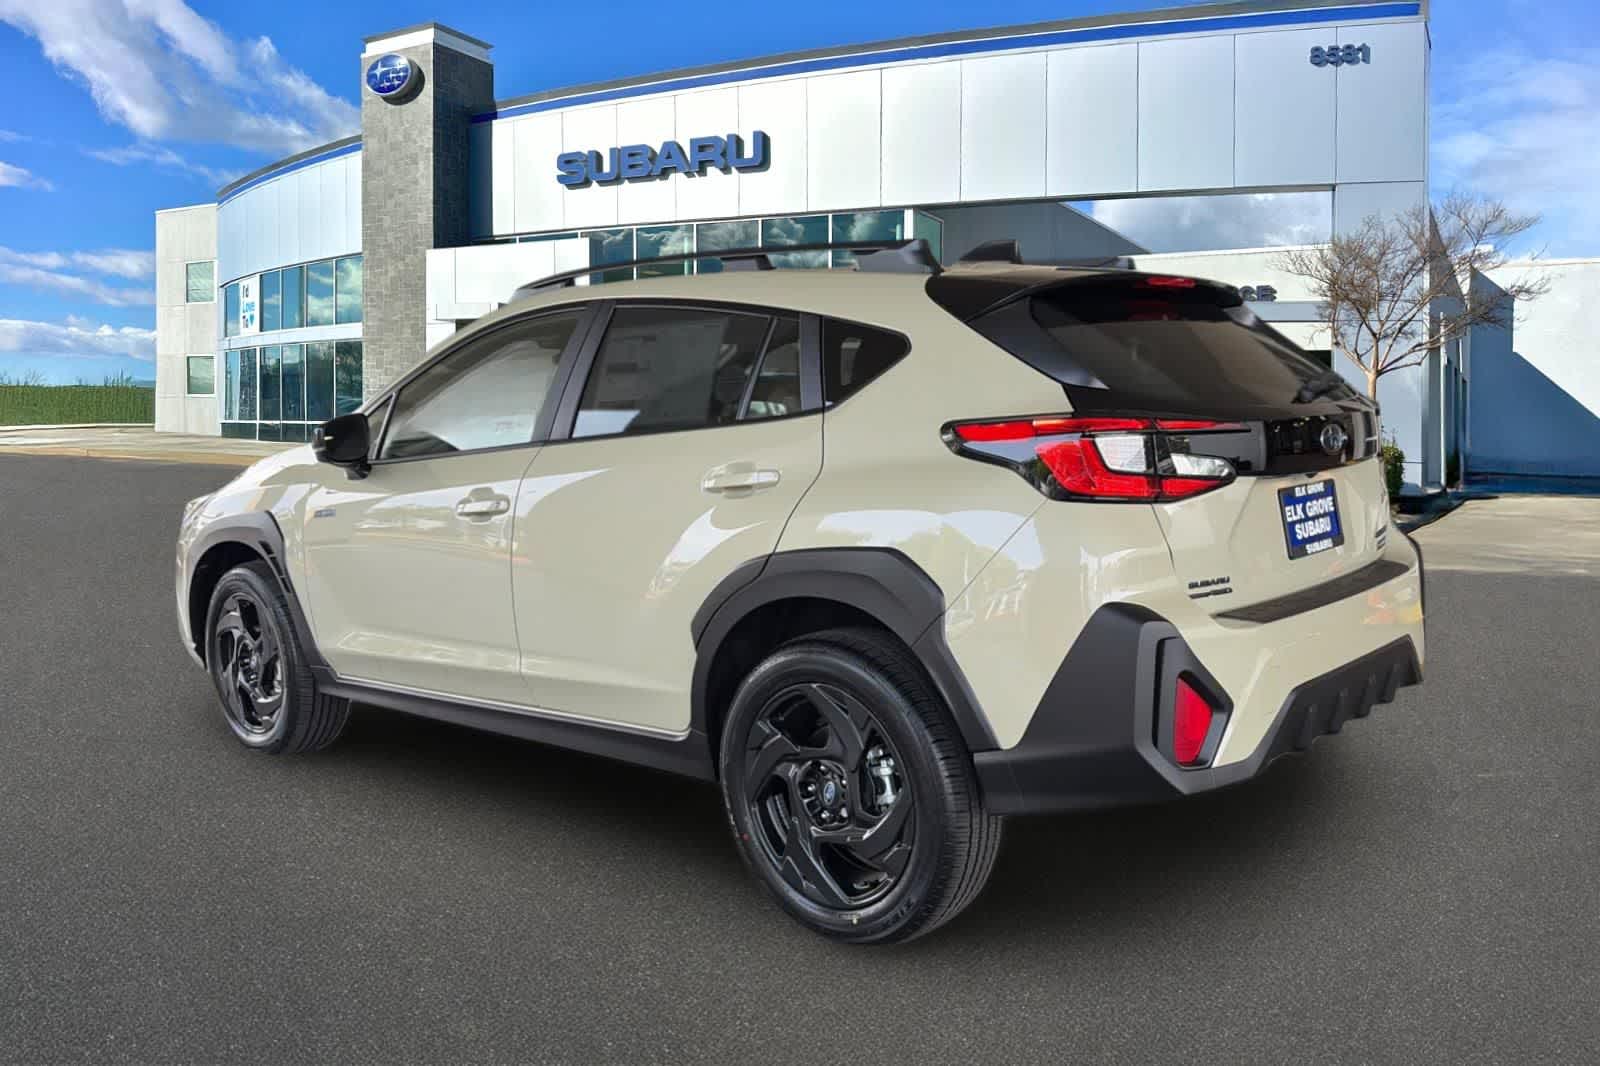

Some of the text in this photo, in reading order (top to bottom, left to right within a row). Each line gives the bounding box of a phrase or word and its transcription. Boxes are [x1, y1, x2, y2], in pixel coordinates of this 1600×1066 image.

[556, 130, 769, 188] SUBARU
[1295, 482, 1325, 497] ELK GROVE
[1285, 496, 1335, 522] ELK GROVE
[1295, 515, 1332, 540] SUBARU
[1305, 538, 1333, 554] SUBARU
[1188, 576, 1231, 590] SUBARU
